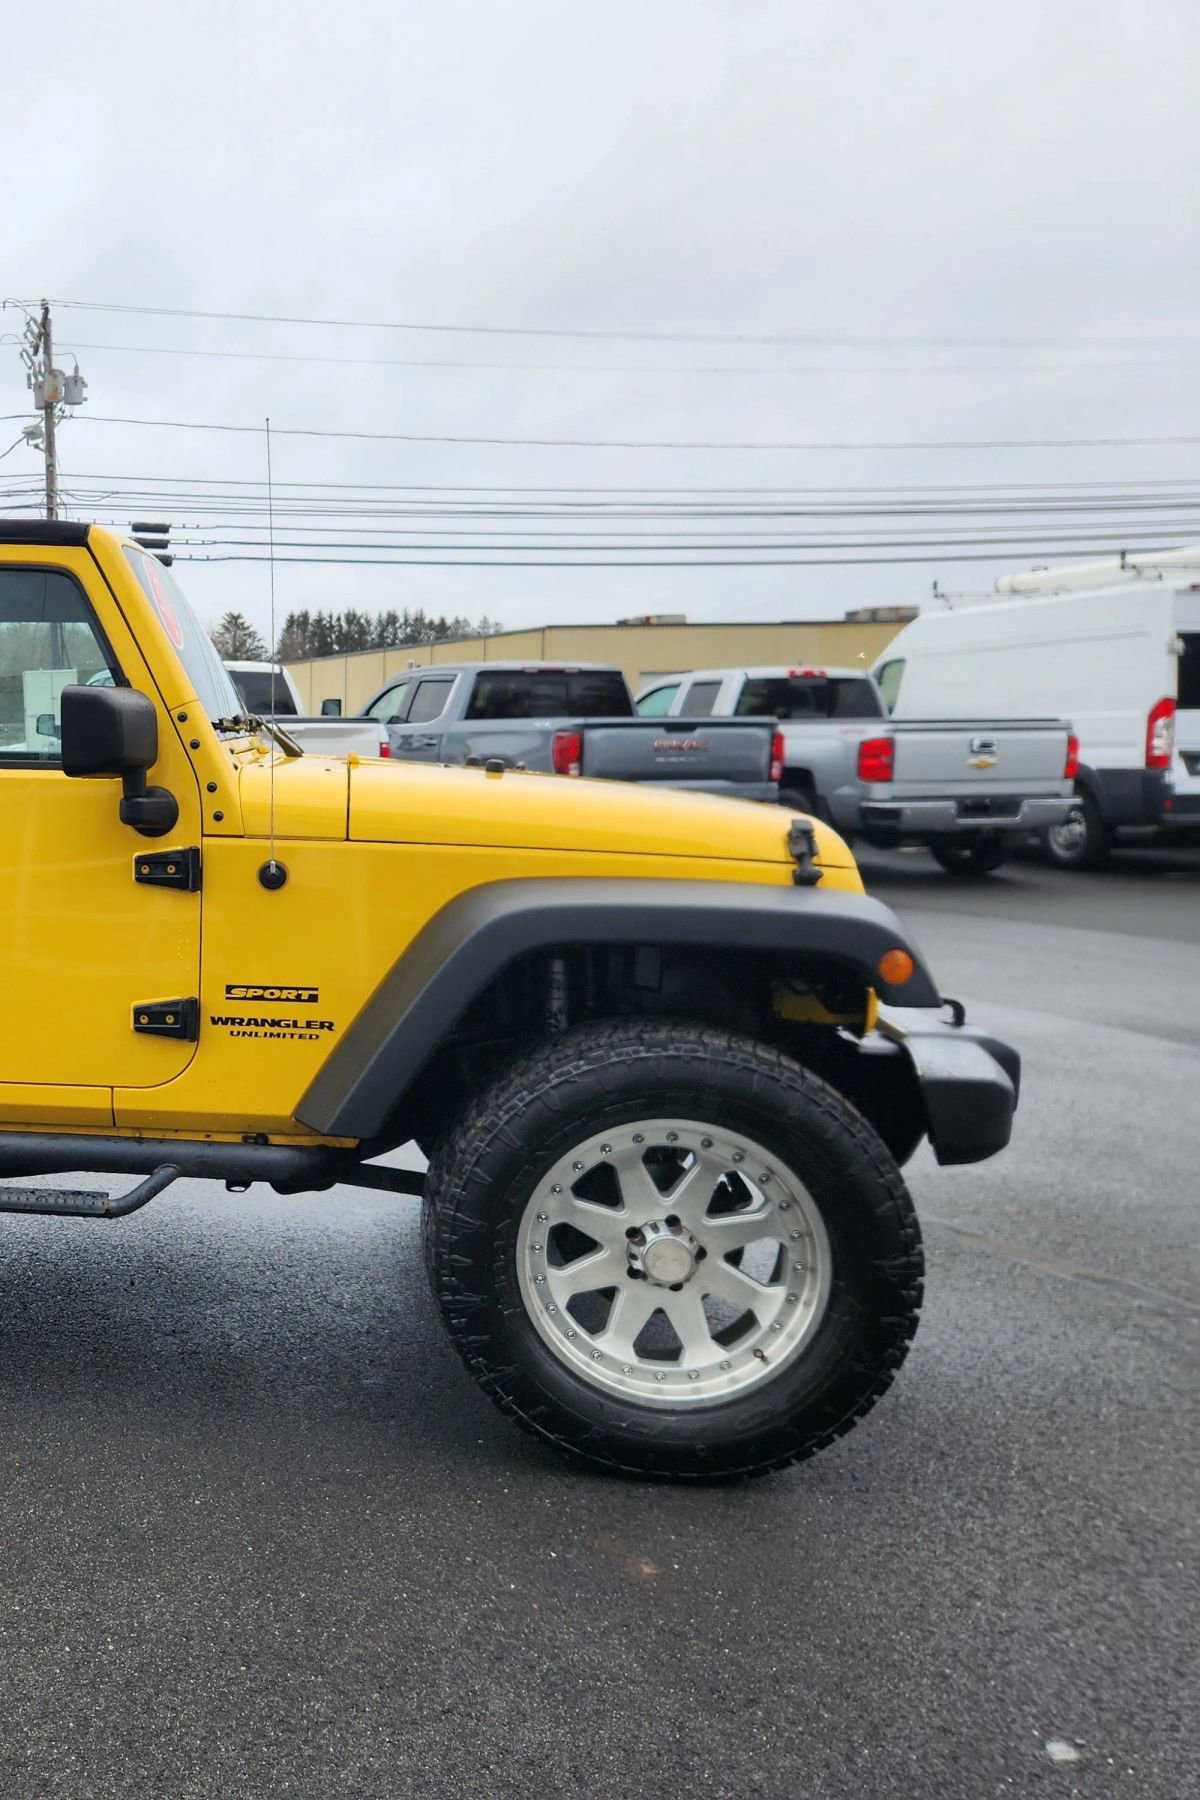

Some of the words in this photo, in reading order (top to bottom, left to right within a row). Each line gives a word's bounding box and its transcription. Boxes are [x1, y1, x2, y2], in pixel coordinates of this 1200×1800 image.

[230, 987, 314, 1000] SPORT
[210, 1016, 335, 1031] WRANGLER
[229, 1030, 319, 1040] UNLIMITED
